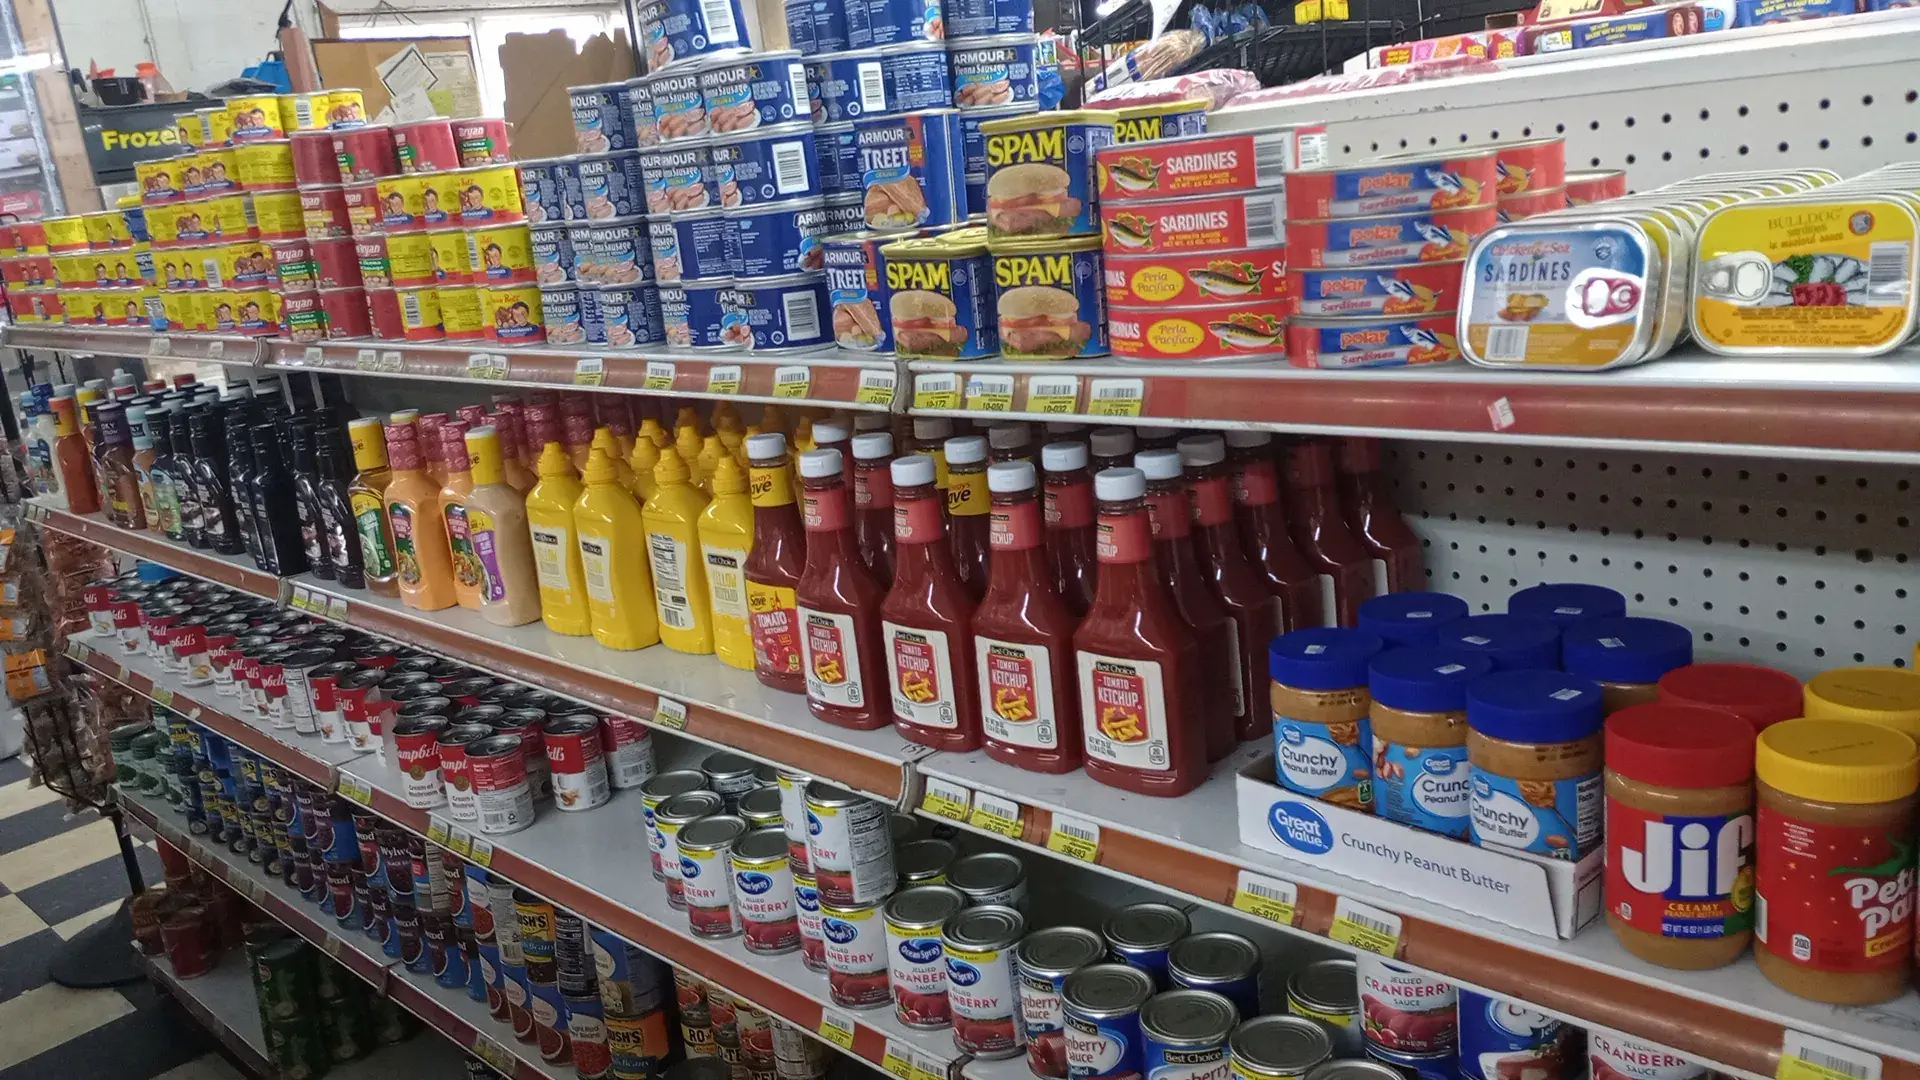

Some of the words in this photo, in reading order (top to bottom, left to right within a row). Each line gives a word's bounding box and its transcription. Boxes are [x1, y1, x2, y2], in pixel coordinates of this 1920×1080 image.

[954, 51, 1005, 64] ARMOUR
[976, 64, 1006, 74] Sausage
[652, 77, 697, 95] ARMOUR
[859, 129, 904, 144] ARMOUR
[987, 129, 1064, 166] SPAM
[862, 147, 908, 168] TREET
[1166, 150, 1237, 175] SARDINES
[1358, 172, 1414, 196] polar
[1358, 196, 1418, 212] Sardines
[1160, 210, 1228, 233] SARDINES
[1768, 211, 1841, 230] BULLDOG
[1349, 225, 1403, 247] polar
[276, 248, 303, 262] Bryan
[1349, 247, 1408, 263] Sardines
[1551, 243, 1570, 254] Sea
[824, 252, 862, 264] ARMOUR
[886, 262, 951, 290] SPAM
[996, 255, 1073, 287] SPAM
[1142, 272, 1168, 284] Perla
[1485, 260, 1571, 283] SARDINES
[828, 268, 865, 290] TREET
[1137, 283, 1176, 297] Pacifica
[1321, 276, 1367, 297] polar
[286, 297, 313, 310] Bryan
[1321, 299, 1372, 313] Sardines
[1159, 324, 1187, 337] Perla
[1154, 336, 1195, 350] Pacifica
[1340, 329, 1389, 350] polar
[1341, 350, 1395, 364] Sardines
[926, 400, 947, 408] 10-172
[983, 402, 1004, 411] 10-050
[1043, 405, 1067, 413] 10-032
[750, 595, 767, 607] Save
[757, 612, 788, 628] TOMATO
[765, 625, 789, 635] KETCHUP
[813, 628, 831, 640] TOMATO
[810, 636, 837, 654] KETCHUP
[907, 633, 927, 643] Choice
[901, 644, 922, 656] TOMATO
[990, 645, 1003, 655] Best
[1003, 648, 1026, 659] Choice
[897, 652, 930, 672] KETCHUP
[996, 658, 1019, 671] TOMATO
[1097, 661, 1110, 672] Best
[1110, 664, 1136, 676] Choice
[991, 669, 1027, 689] KETCHUP
[1103, 678, 1129, 690] TOMATO
[1097, 688, 1138, 707] KETCHUP
[1281, 746, 1338, 770] Crunchy
[1283, 759, 1310, 774] Peanut
[1311, 767, 1337, 777] Butter
[1424, 794, 1460, 805] Peanut
[849, 806, 872, 815] Nutrition
[1471, 797, 1529, 828] Crunchy
[1274, 807, 1322, 838] Great
[1287, 825, 1323, 848] Value
[1498, 825, 1528, 839] Butter
[1621, 815, 1753, 897] Jif
[1341, 832, 1401, 862] Crunchy
[1404, 851, 1458, 878] Peanut
[1461, 867, 1510, 895] Butter
[1250, 905, 1280, 922] 36-910
[1668, 903, 1719, 913] CREAMY
[901, 945, 921, 959] Ocean
[921, 945, 940, 960] Spray
[956, 968, 974, 982] Spray
[1390, 976, 1421, 985] JELLIED
[1026, 978, 1052, 991] Choice
[1364, 976, 1452, 998] CRANBERRY
[1393, 998, 1420, 1007] SAUCE
[1025, 1007, 1049, 1020] Sauce
[1068, 1021, 1097, 1035] Choice
[1067, 1049, 1093, 1064] Sauce
[1166, 1052, 1186, 1063] Best
[1187, 1050, 1222, 1062] Choice
[1625, 1066, 1657, 1076] SAUCE
